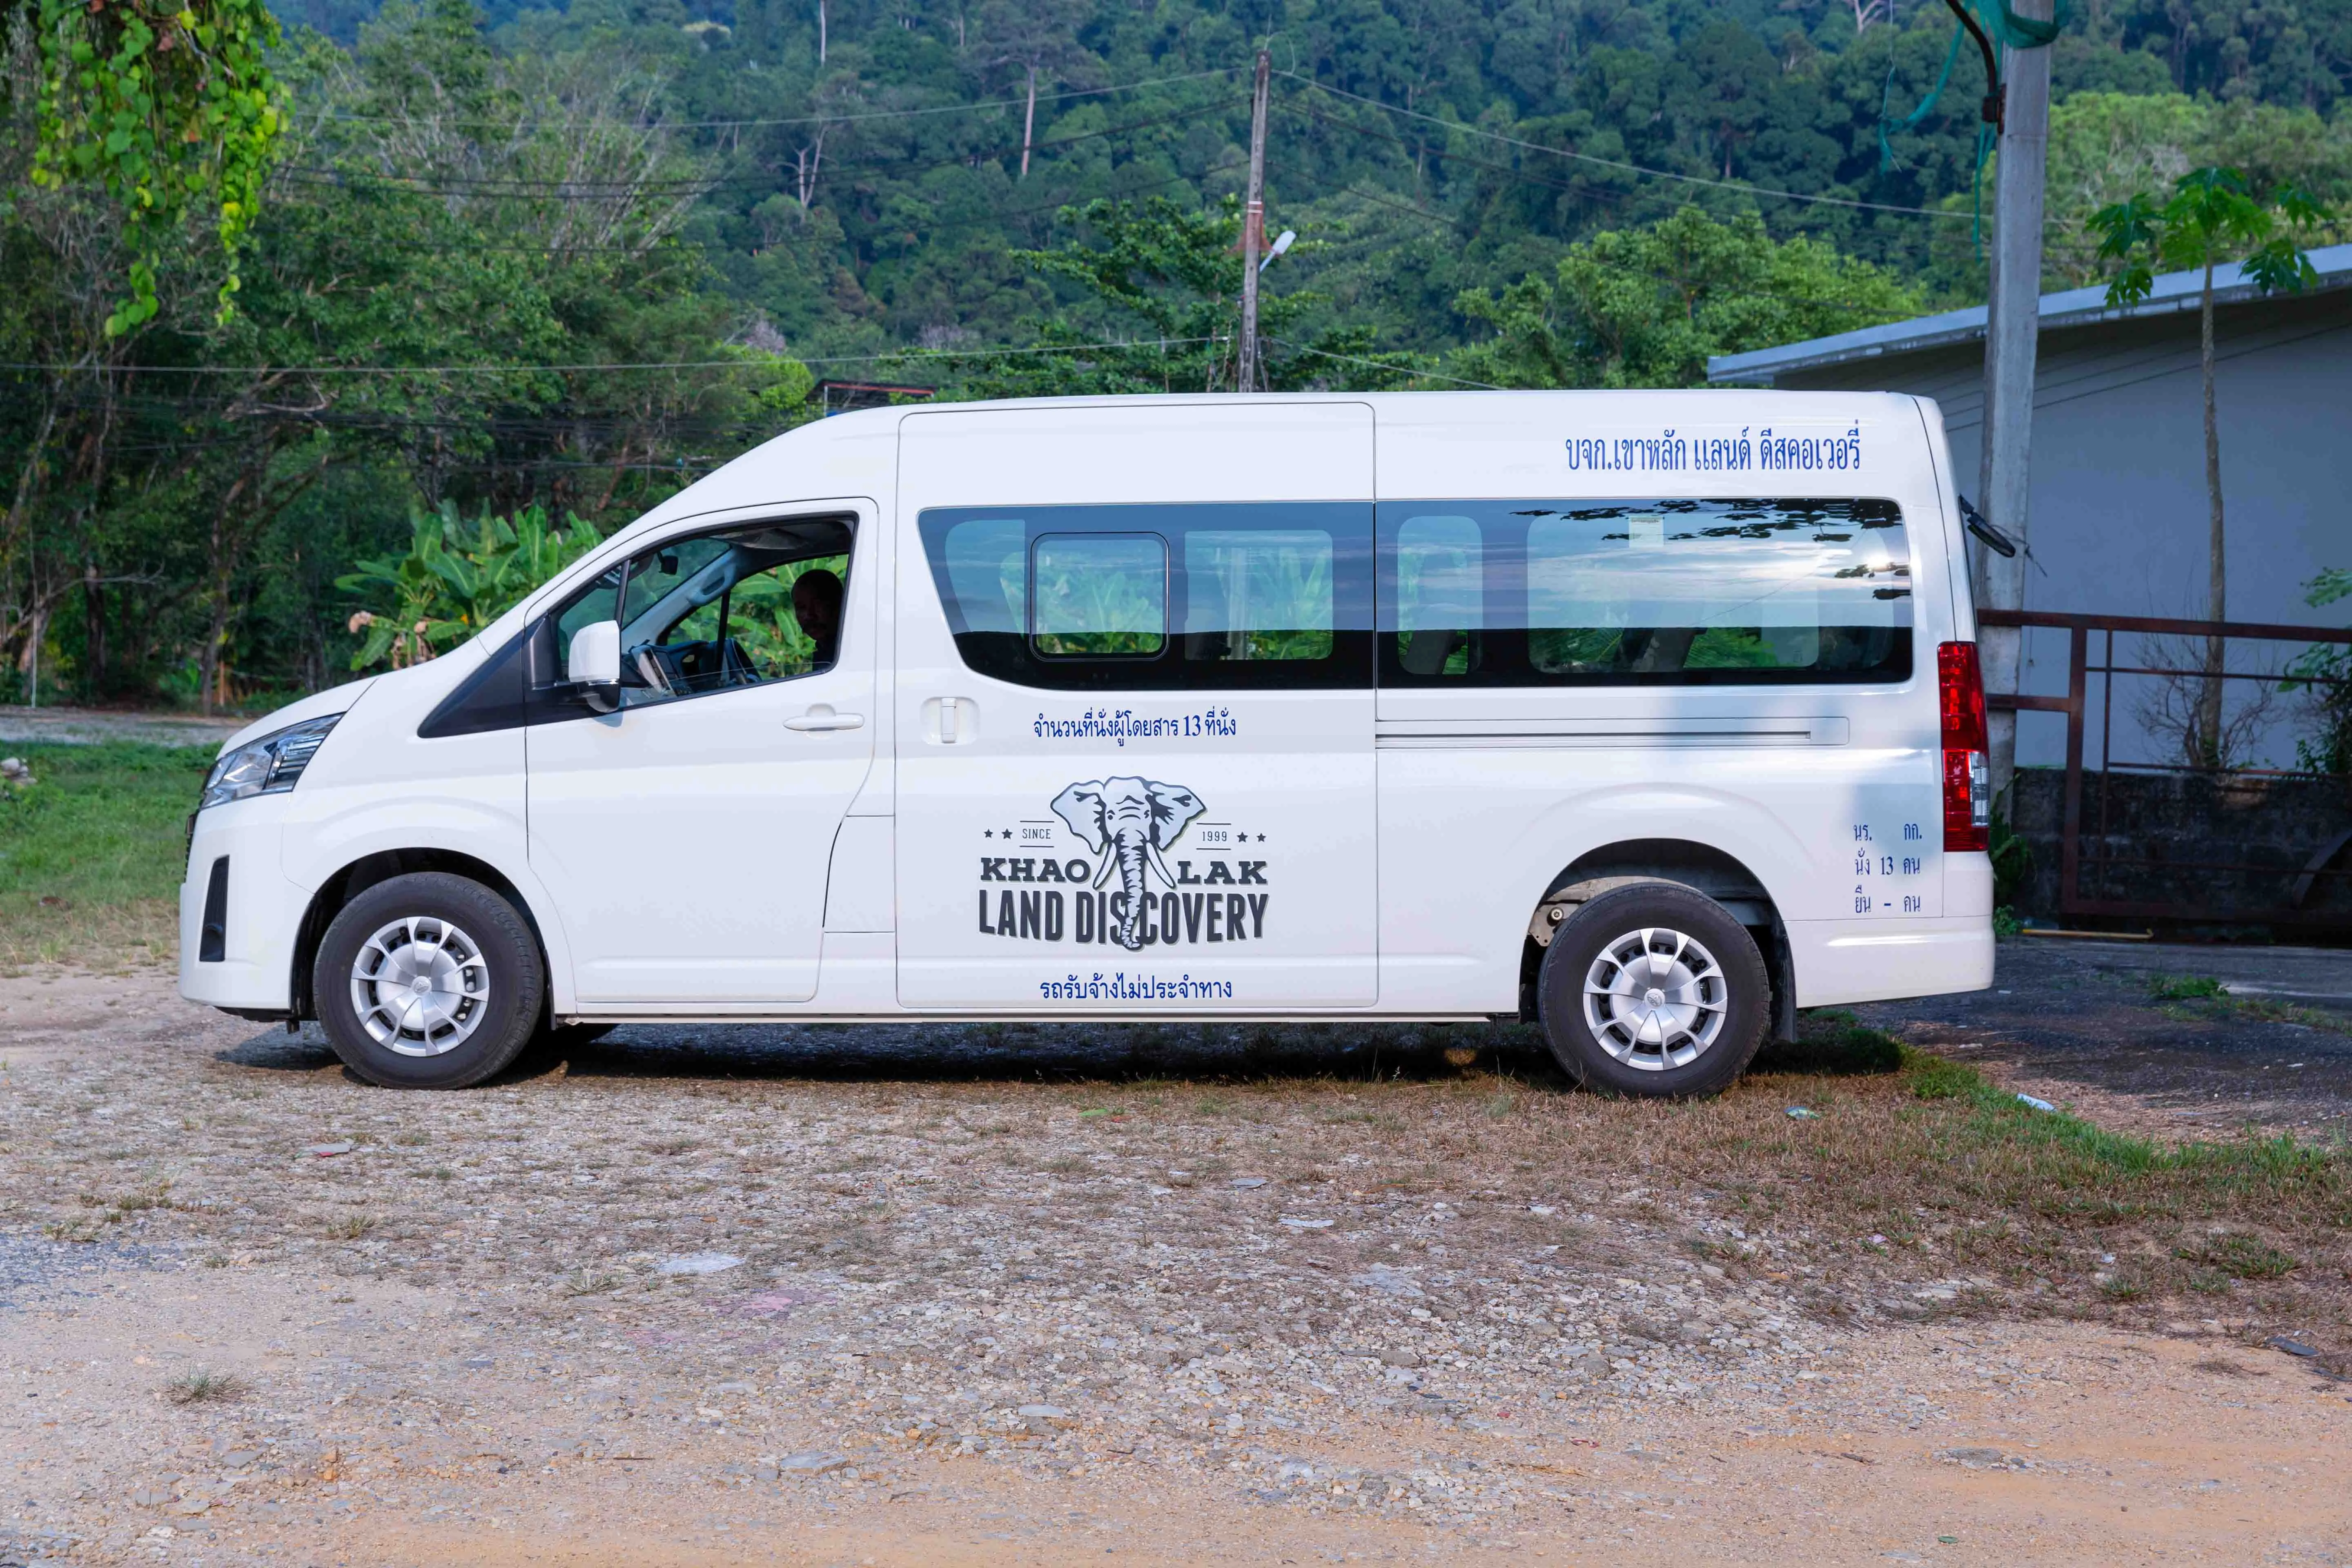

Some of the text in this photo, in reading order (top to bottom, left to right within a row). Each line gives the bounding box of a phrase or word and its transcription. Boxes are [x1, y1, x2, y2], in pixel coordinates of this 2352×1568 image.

[1565, 429, 1686, 470] บจก.เขาหลัก
[1033, 706, 1179, 747] จำนวนที่นั่งผู้โดยสาร
[1183, 715, 1201, 736] 13
[1022, 828, 1051, 839] SINCE
[1202, 831, 1227, 842] 1999
[980, 857, 1267, 884] KHAO LAK
[1855, 846, 1921, 876] นั่ง 13 คน
[979, 889, 1269, 945] LAND DISCOVERY
[1903, 895, 1921, 913] คน
[1040, 972, 1232, 999] รถรับจ้างไม่ประจำทาง
